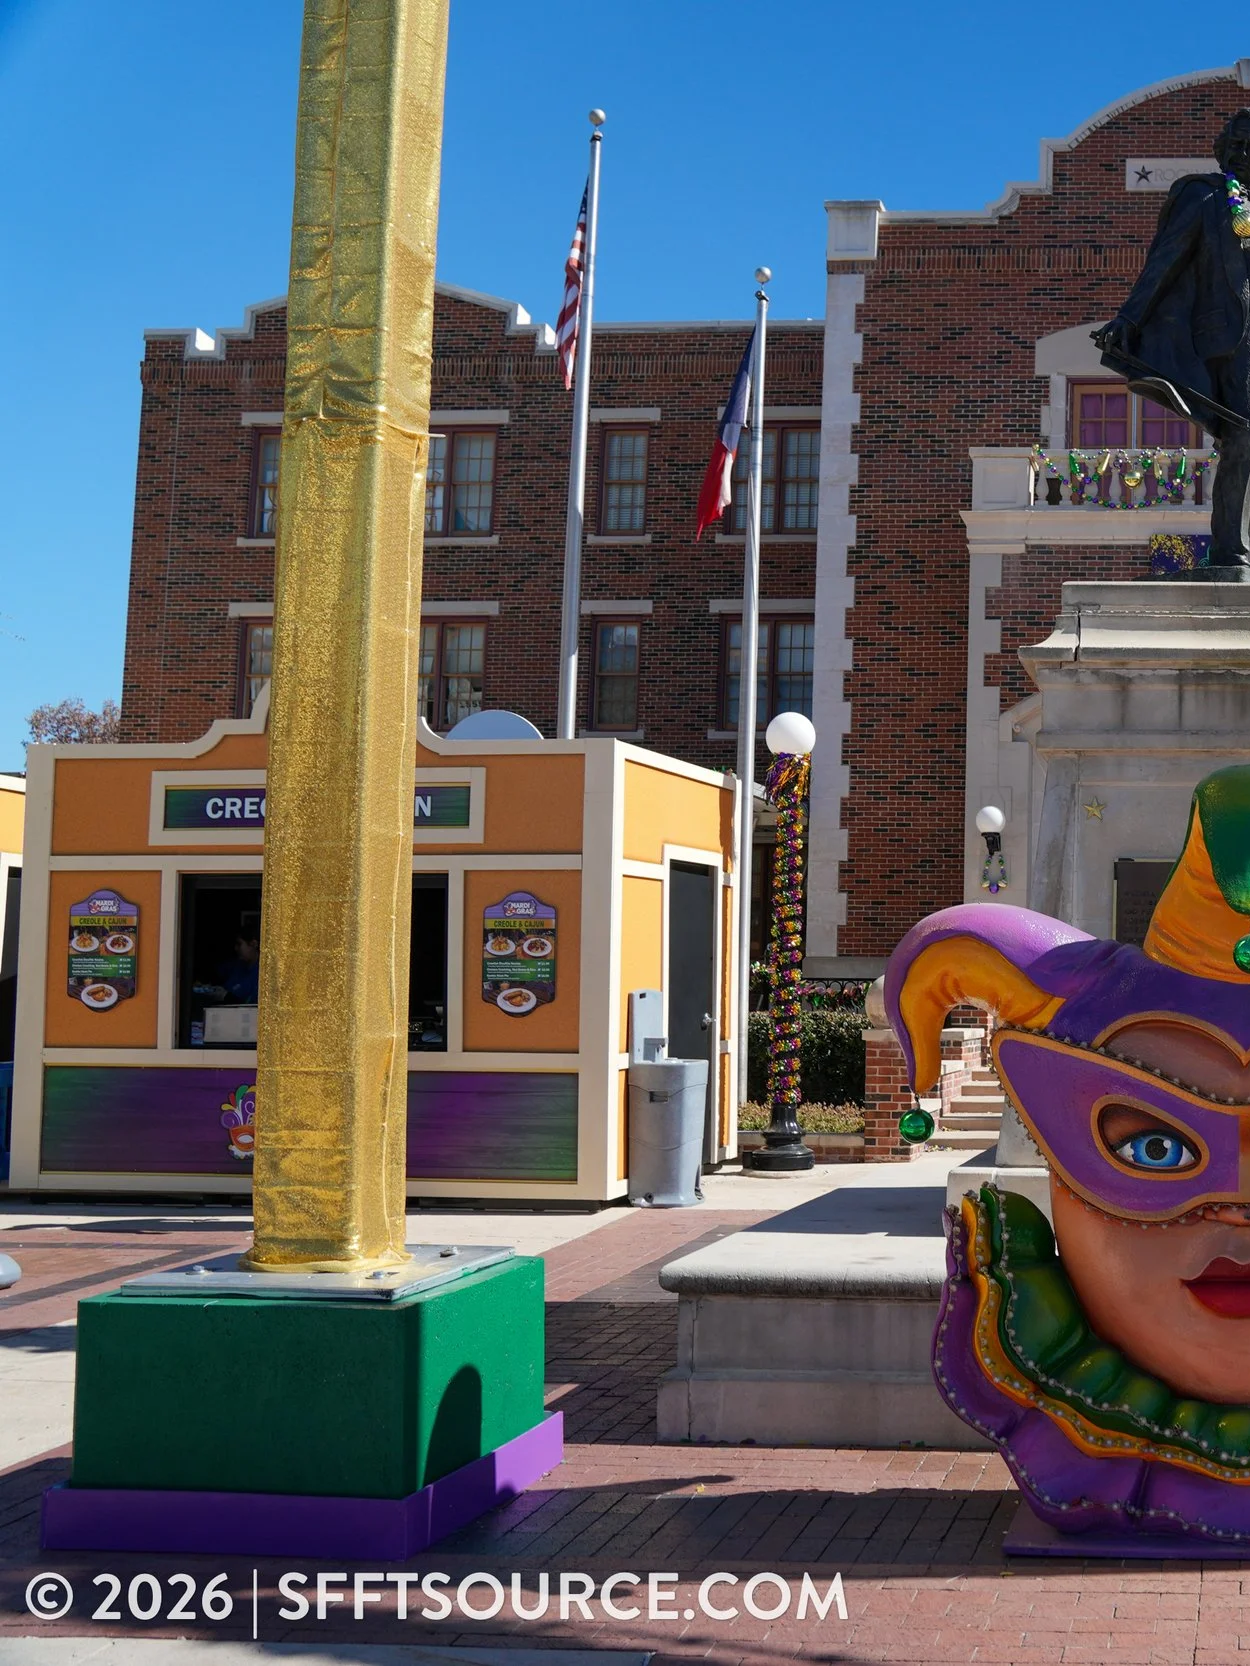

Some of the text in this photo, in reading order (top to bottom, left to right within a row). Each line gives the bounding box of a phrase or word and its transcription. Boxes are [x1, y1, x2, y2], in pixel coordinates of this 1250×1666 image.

[79, 917, 101, 925] CREOLE
[108, 917, 127, 925] CAJUN
[493, 920, 517, 928] CREOLE
[524, 920, 545, 928] CAJUN
